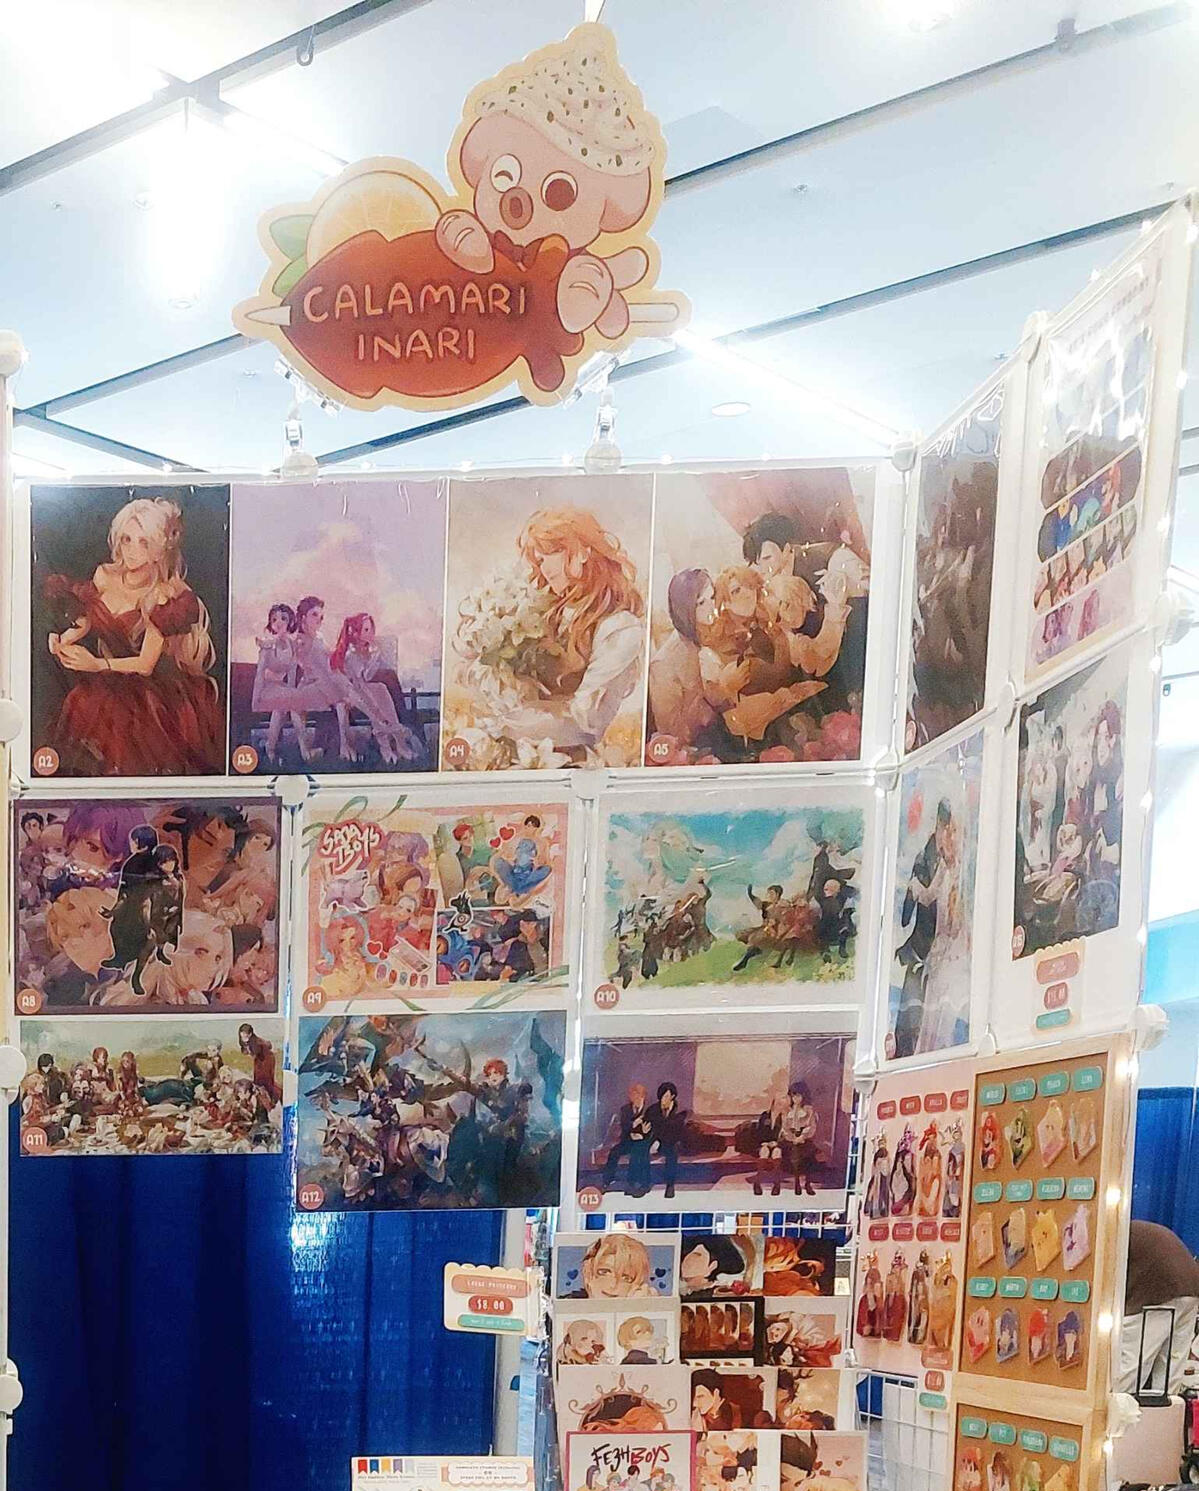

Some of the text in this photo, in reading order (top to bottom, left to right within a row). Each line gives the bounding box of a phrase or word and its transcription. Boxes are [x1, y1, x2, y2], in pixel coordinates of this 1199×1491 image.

[303, 281, 526, 323] CALAMARI
[358, 328, 475, 362] INARI
[449, 745, 465, 757] A4
[653, 743, 669, 755] A5
[38, 755, 53, 767] A2
[237, 752, 253, 765] A3
[22, 995, 36, 1007] A8
[307, 991, 322, 1003] A9
[596, 990, 617, 1002] A10
[26, 1134, 43, 1145] A11
[301, 1190, 320, 1203] A12
[580, 1193, 599, 1205] A13
[476, 1299, 505, 1310] $8.00
[590, 1443, 671, 1474] FE3H BOYS
